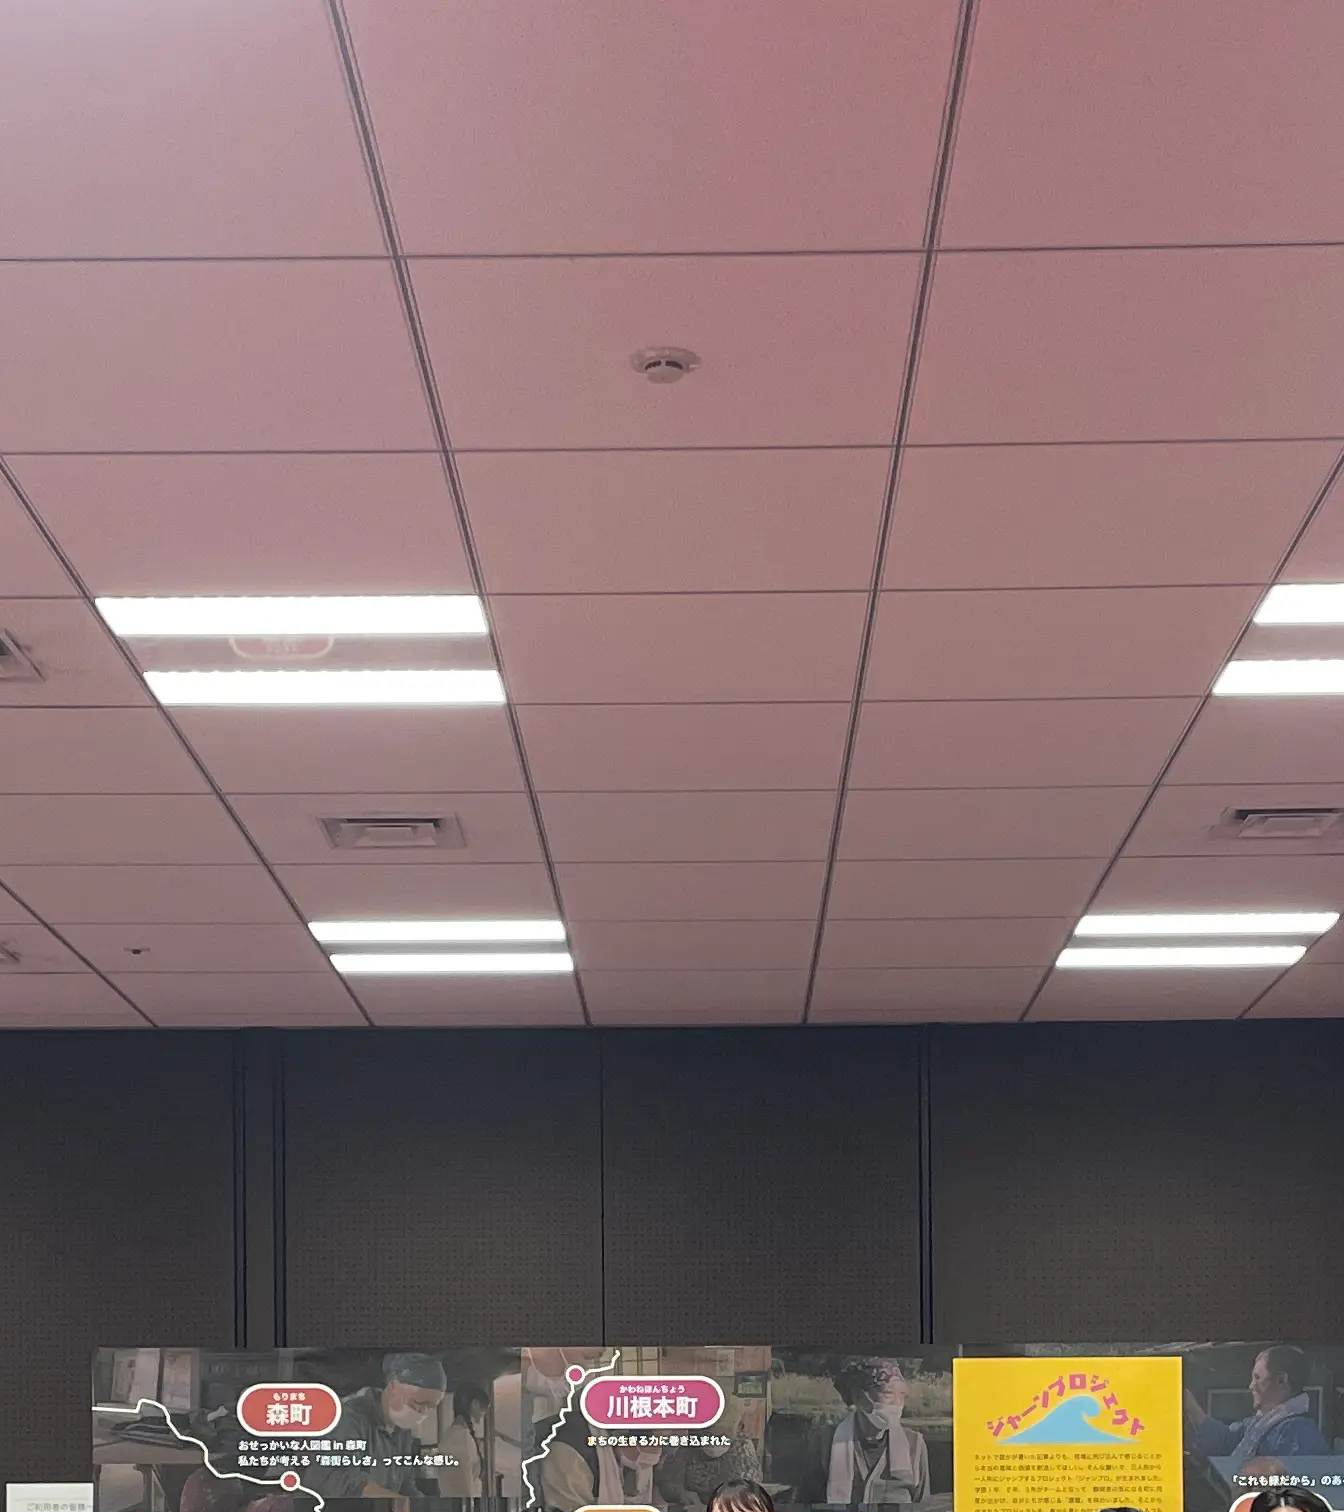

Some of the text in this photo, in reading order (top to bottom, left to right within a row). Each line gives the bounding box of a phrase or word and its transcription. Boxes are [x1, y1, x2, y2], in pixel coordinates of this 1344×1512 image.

[272, 1392, 306, 1401] もりまち
[607, 1395, 699, 1418] 川根本町
[265, 1403, 313, 1426] 森町
